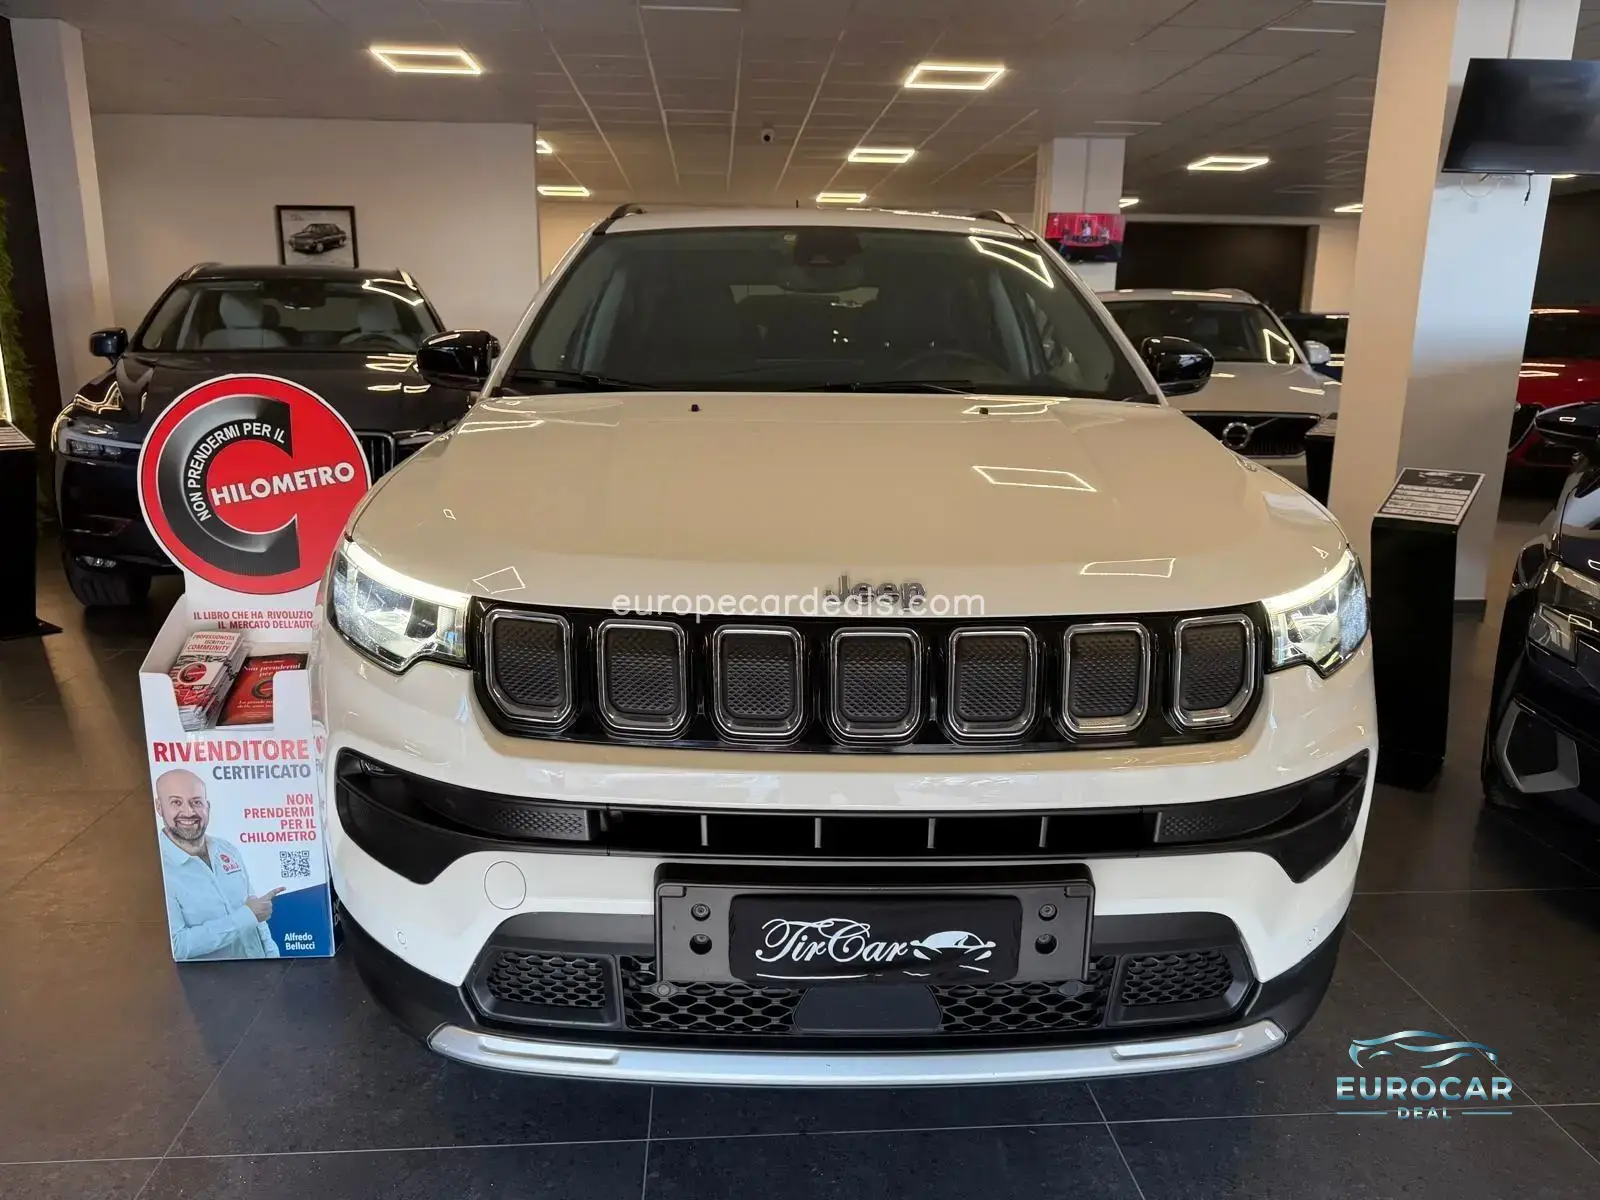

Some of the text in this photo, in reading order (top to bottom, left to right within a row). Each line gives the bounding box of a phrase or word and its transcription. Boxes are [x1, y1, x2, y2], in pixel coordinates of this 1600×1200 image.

[187, 422, 285, 522] NON PRENDERMI PER IL
[823, 575, 926, 611] Jeep
[193, 611, 202, 620] IL
[203, 611, 230, 620] LIBRO
[232, 611, 249, 620] CHE
[251, 611, 264, 620] HA
[217, 620, 227, 629] IL
[229, 620, 271, 629] MERCATO
[153, 739, 310, 763] RIVENDITORE
[212, 764, 311, 780] CERTIFICATO
[286, 794, 313, 805] NON
[244, 807, 315, 819] PRENDERMI
[280, 819, 316, 830] PER IL
[239, 831, 316, 843] CHILOMETRO
[284, 932, 313, 942] Alfredo
[755, 917, 908, 962] TirCar
[285, 941, 315, 951] Bellucci
